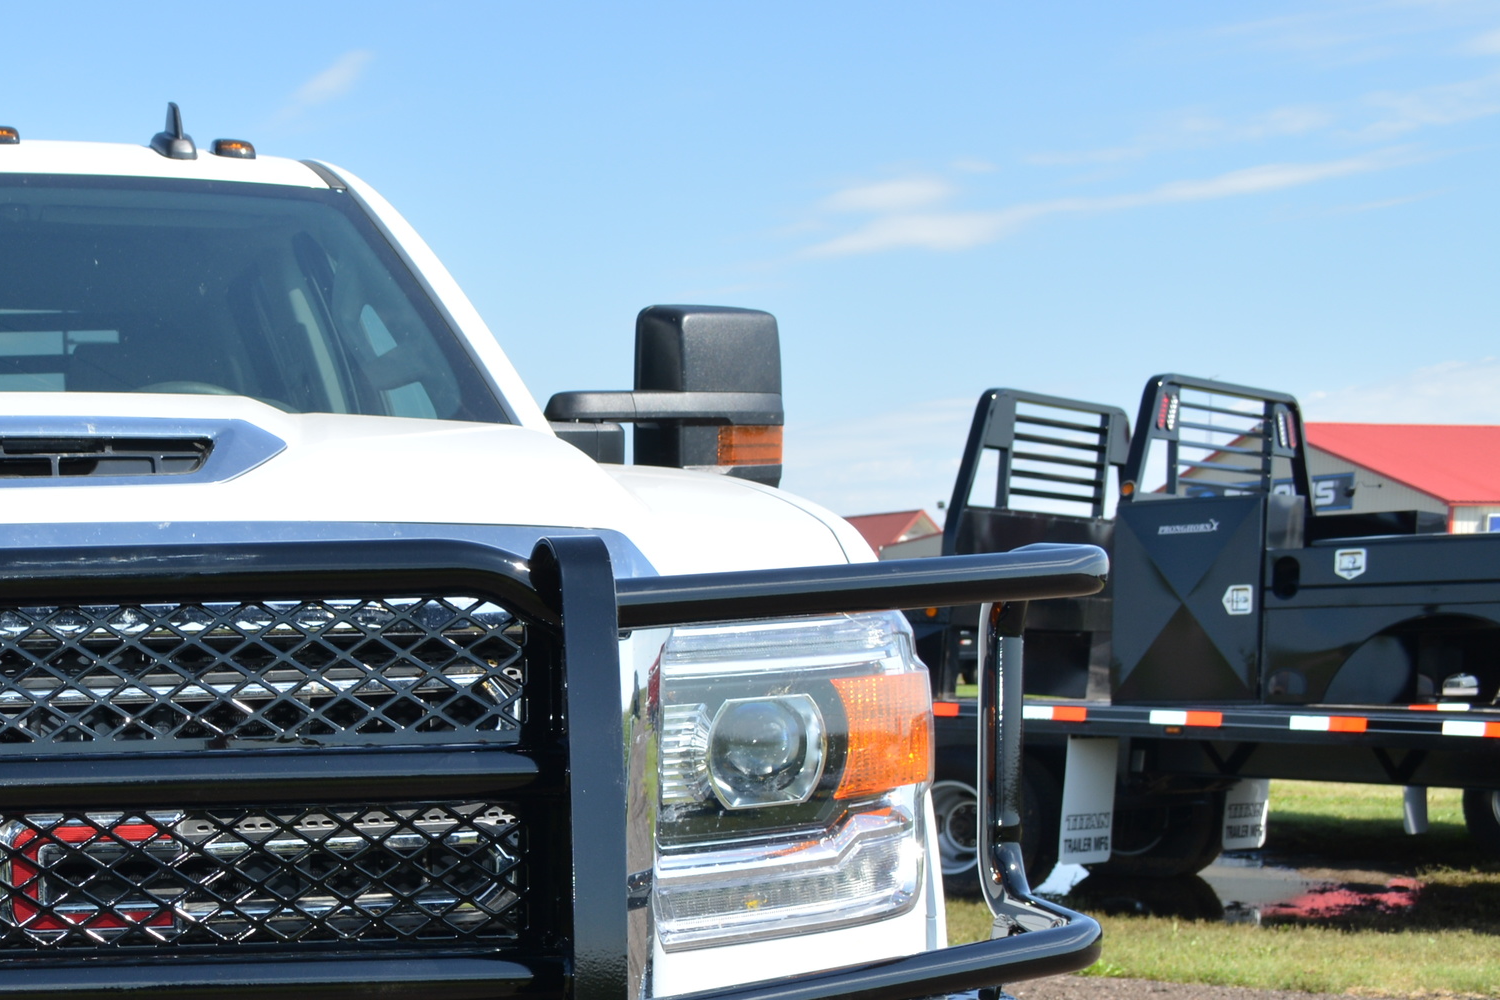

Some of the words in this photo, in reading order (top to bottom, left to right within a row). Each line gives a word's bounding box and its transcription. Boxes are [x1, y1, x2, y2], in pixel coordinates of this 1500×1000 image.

[1228, 802, 1264, 818] TITAN
[1066, 812, 1111, 831] TITAN
[1064, 837, 1092, 853] TRAILER
[1093, 836, 1109, 851] MFG
